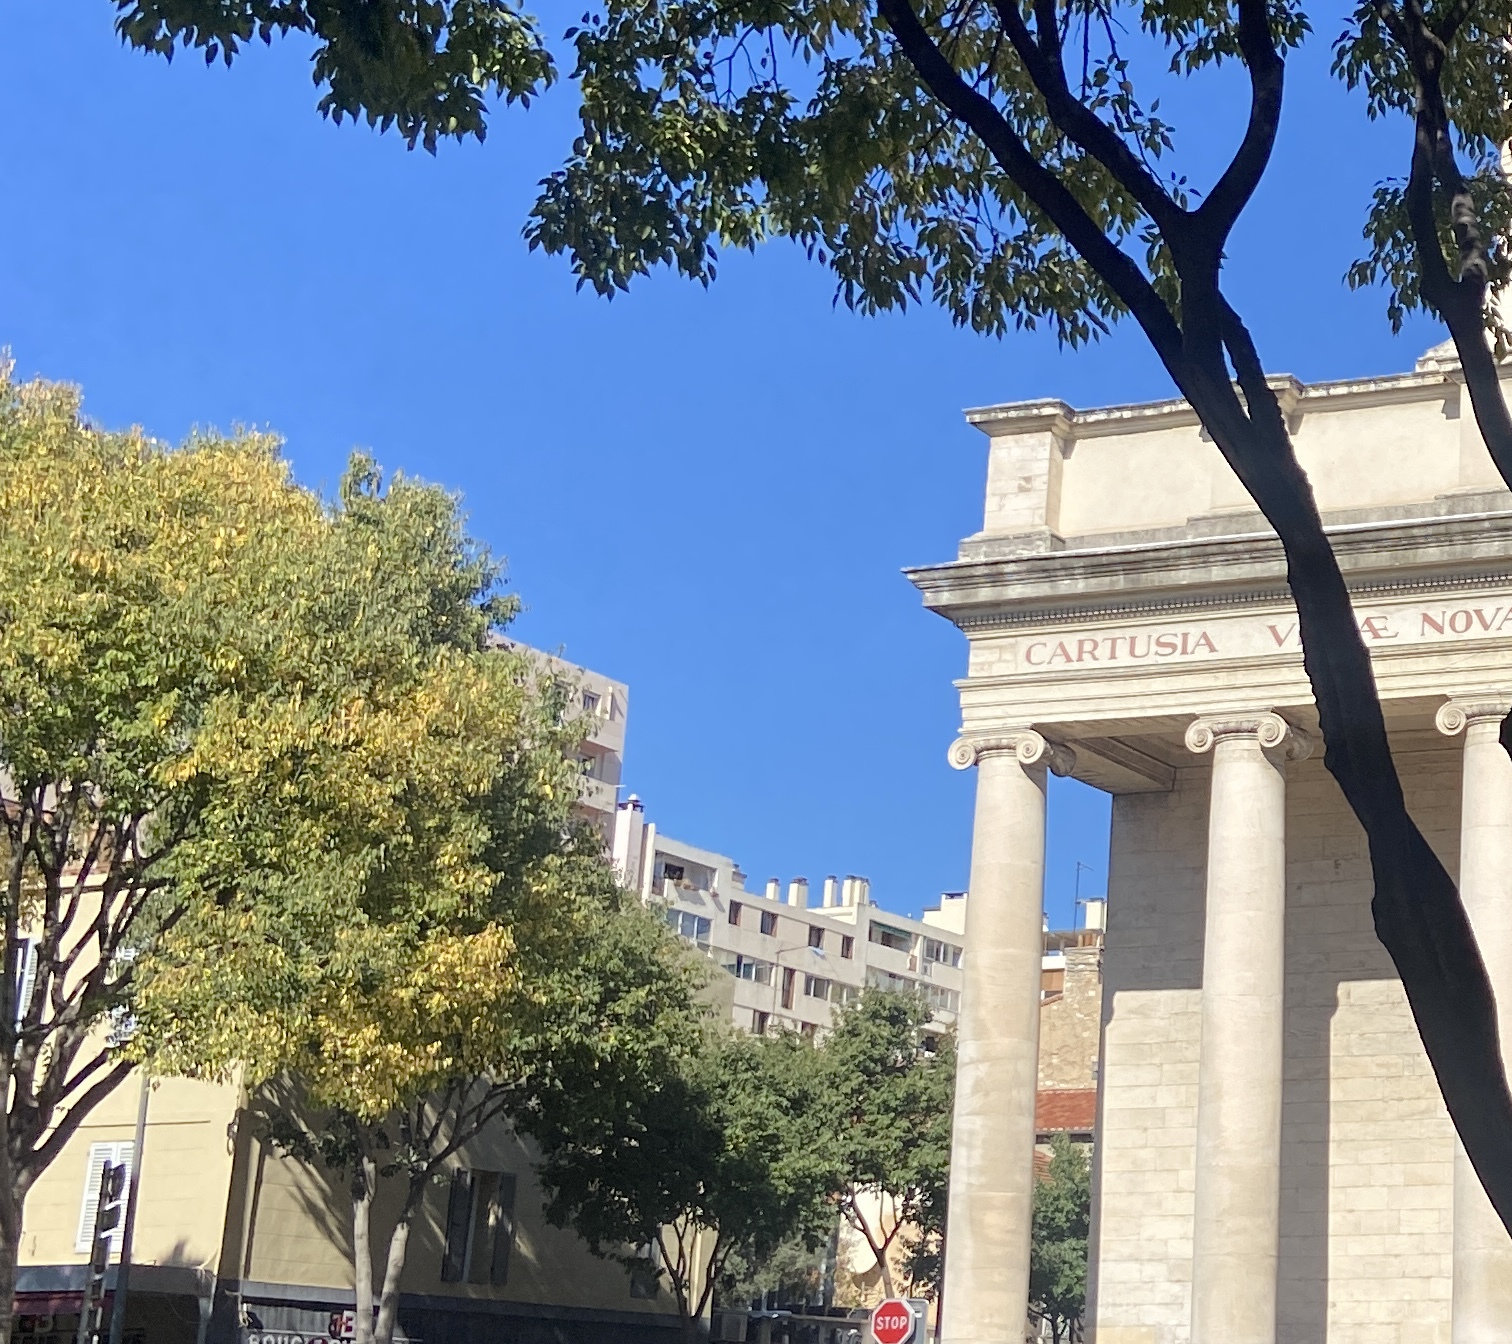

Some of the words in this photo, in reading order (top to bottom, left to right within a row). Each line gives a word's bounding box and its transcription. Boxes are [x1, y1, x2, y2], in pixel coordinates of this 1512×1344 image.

[1025, 631, 1219, 666] CARTUSIA
[1268, 615, 1399, 648] VÆ
[876, 1316, 908, 1330] STOP
